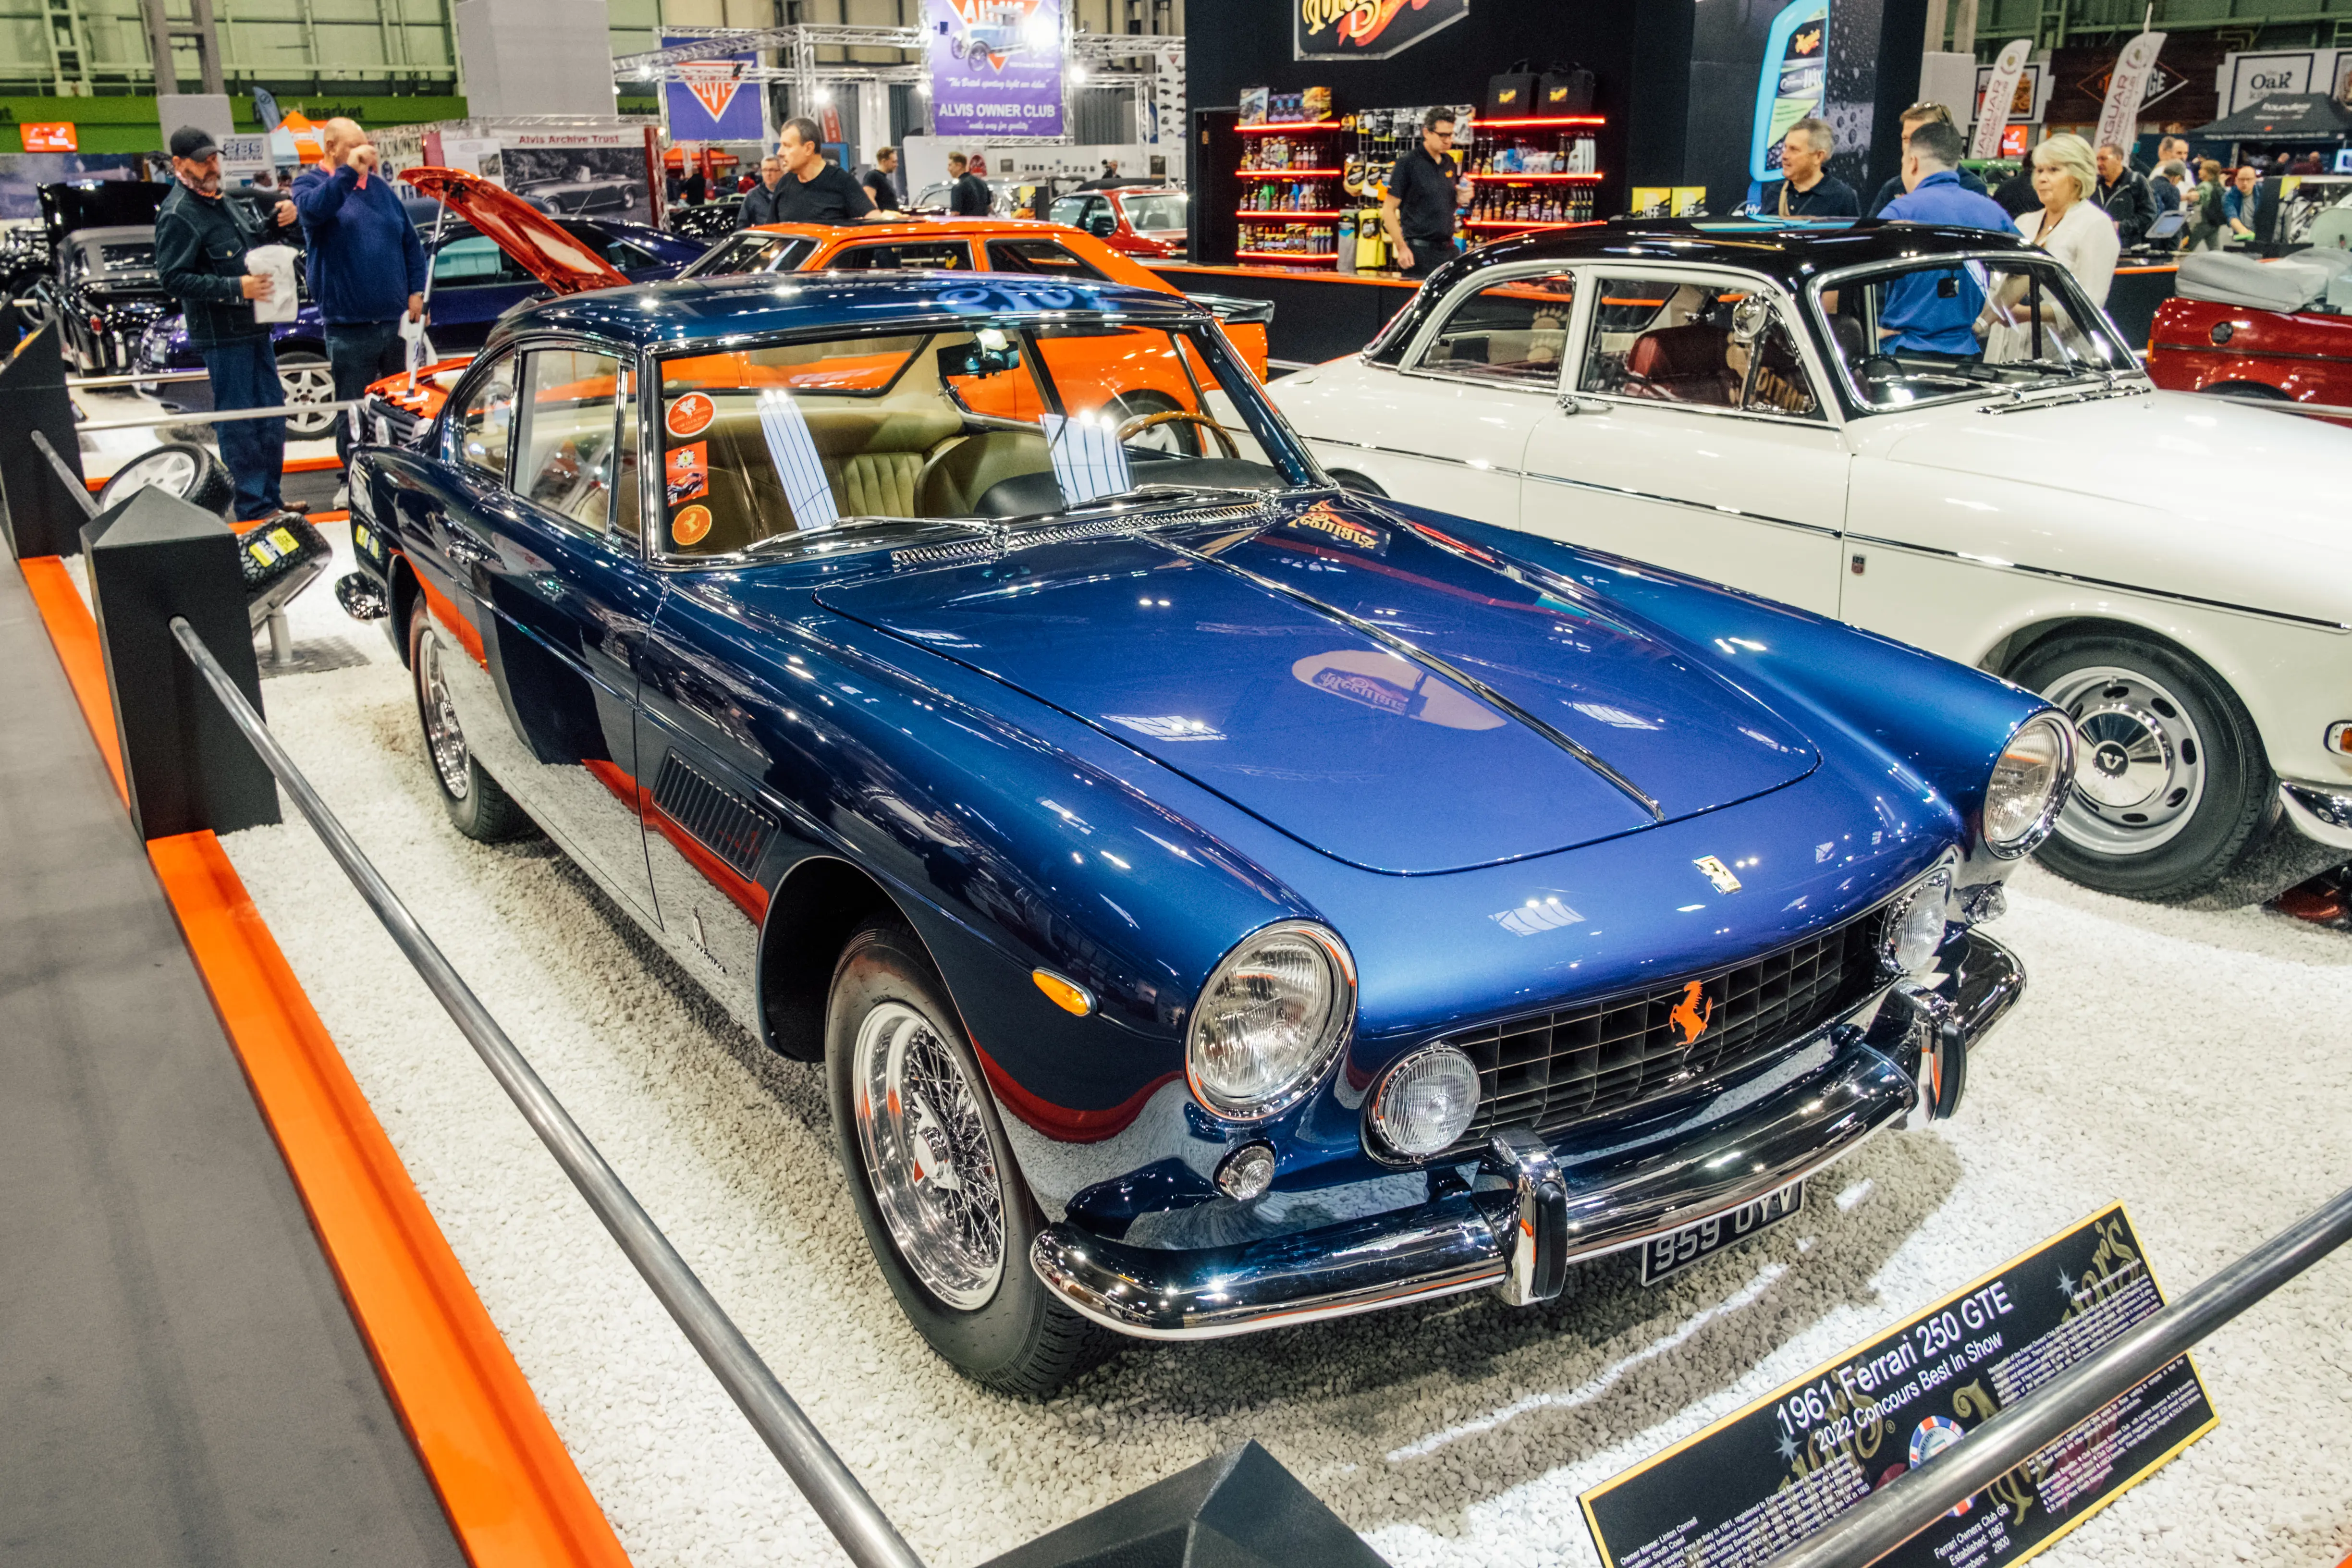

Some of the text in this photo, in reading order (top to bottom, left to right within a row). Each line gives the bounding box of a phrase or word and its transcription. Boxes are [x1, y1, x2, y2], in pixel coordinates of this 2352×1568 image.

[2251, 72, 2292, 89] Oak
[306, 103, 364, 118] market
[939, 103, 1055, 117] ALVIS OWNER CLUB
[1976, 79, 2002, 155] JAGUAR
[2101, 74, 2129, 146] AGUAR
[519, 135, 619, 144] Alvis Archive Trust
[2100, 752, 2123, 769] V
[1654, 1217, 1720, 1271] 959
[1776, 1280, 2013, 1434] 1961 Ferrari 250 GTE
[1814, 1416, 1854, 1452] 2022
[1853, 1382, 1920, 1431] Concours
[1918, 1359, 1953, 1391] Best
[1949, 1354, 1967, 1372] In
[1964, 1332, 2002, 1362] Show
[1661, 1547, 1686, 1566] supplied
[1684, 1542, 1698, 1553] new
[1695, 1538, 1703, 1547] in
[1701, 1531, 1714, 1543] Italy
[1734, 1503, 1761, 1524] registered
[1765, 1487, 1788, 1506] Edmund
[1809, 1467, 1825, 1479] Rome
[1824, 1460, 1835, 1470] with
[1696, 1557, 1711, 1568] films
[1709, 1543, 1734, 1561] including
[1733, 1527, 1761, 1547] Barbarella
[1759, 1521, 1771, 1532] with
[1771, 1514, 1784, 1525] Jane
[1818, 1485, 1830, 1495] with
[1834, 1473, 1851, 1486] Pacino
[1850, 1466, 1862, 1477] and
[1698, 1542, 1716, 1556] widely
[1715, 1528, 1739, 1546] believed
[1737, 1516, 1760, 1533] however
[1759, 1513, 1766, 1521] to
[1764, 1506, 1778, 1517] have
[1777, 1497, 1792, 1509] been
[1790, 1489, 1804, 1502] used
[1803, 1486, 1811, 1494] by
[1809, 1479, 1823, 1491] Dino
[1822, 1475, 1829, 1483] de
[1720, 1549, 1743, 1568] amongst
[1741, 1544, 1752, 1554] the
[1775, 1523, 1788, 1534] films
[1787, 1519, 1795, 1527] he
[1794, 1505, 1818, 1524] produced
[1834, 1488, 1845, 1497] The
[1844, 1483, 1853, 1492] car
[1851, 1477, 1863, 1487] was
[1742, 1553, 1756, 1566] Park
[1790, 1526, 1802, 1536] who
[1800, 1511, 1824, 1531] imported
[1835, 1500, 1844, 1509] the
[1843, 1493, 1853, 1504] UK
[1934, 1503, 2009, 1559] Ferrari Owners Club GB
[1620, 1516, 1698, 1566] Owner Name: Linton Connell
[1652, 1545, 1669, 1559] South
[1668, 1535, 1686, 1550] Coast
[1948, 1521, 2004, 1566] Established: 1967
[1992, 1535, 2010, 1554] 2800
